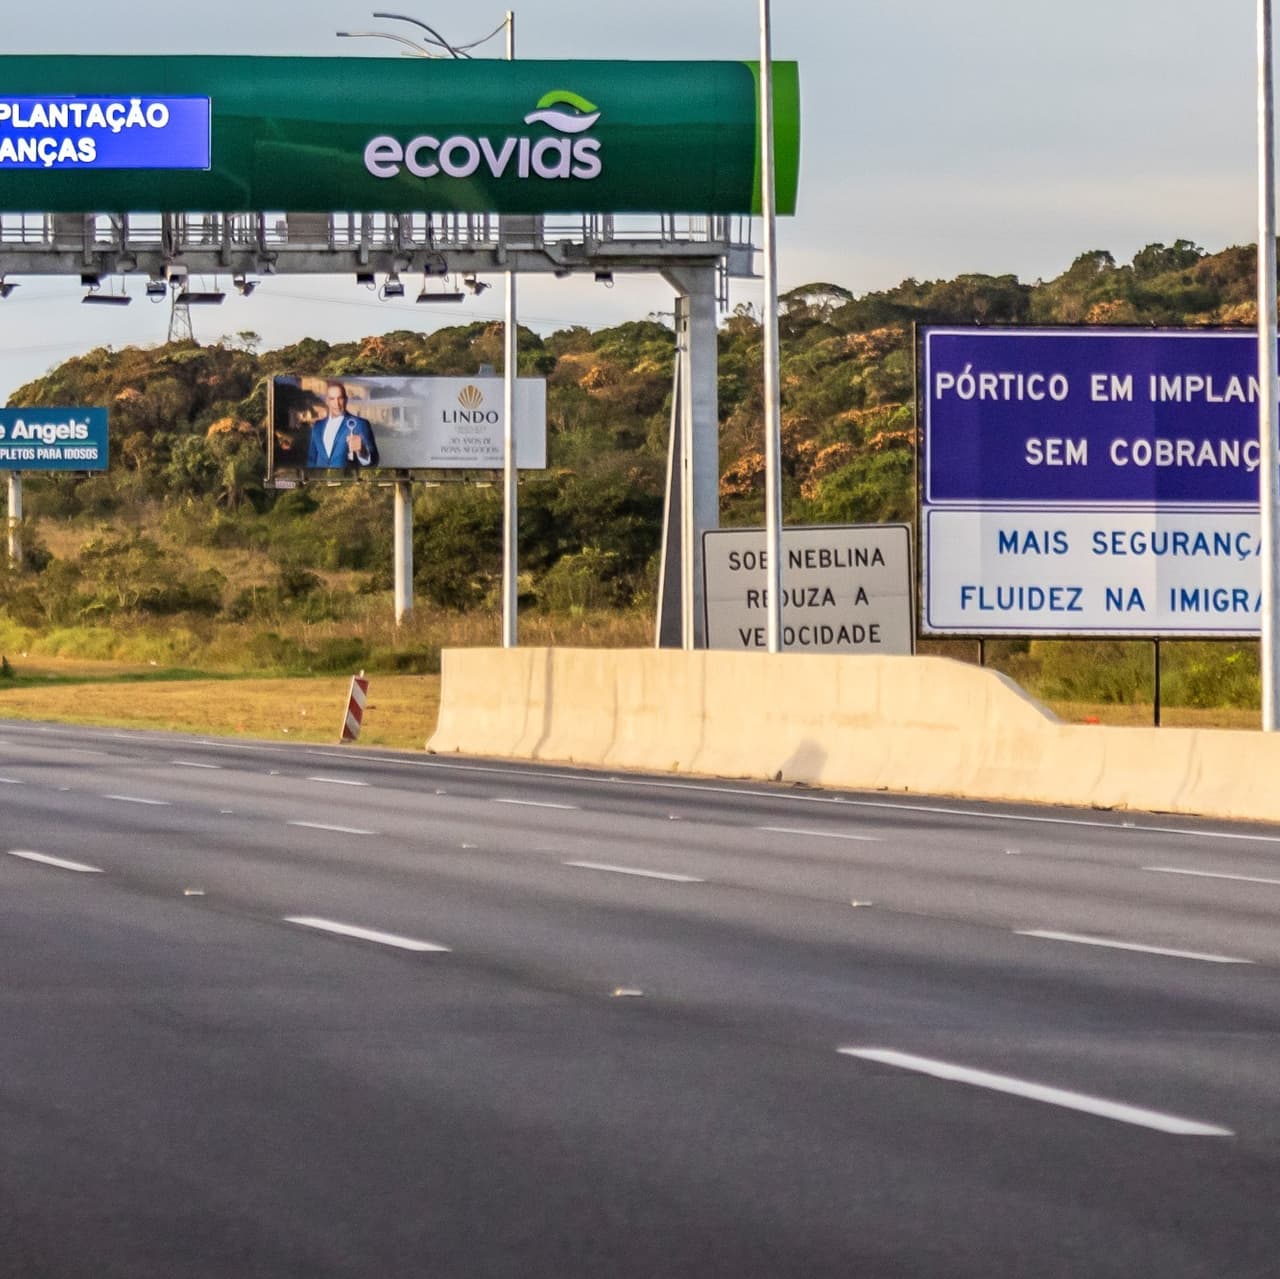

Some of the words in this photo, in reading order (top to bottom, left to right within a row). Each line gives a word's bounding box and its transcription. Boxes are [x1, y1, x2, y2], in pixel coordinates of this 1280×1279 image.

[364, 136, 601, 178] ecovias
[936, 364, 1068, 400] PÓRTICO
[1092, 374, 1132, 401] EM
[443, 411, 498, 423] LINDO
[12, 419, 89, 444] Angels
[37, 448, 61, 459] PARA
[64, 448, 97, 459] IDOSOS
[1026, 438, 1087, 465] SEM
[789, 548, 885, 568] NEBLINA
[999, 531, 1068, 554] MAIS
[1093, 531, 1261, 561] SEGURANÇ
[855, 587, 868, 605] A
[961, 586, 1082, 611] FLUIDEZ
[1106, 588, 1145, 610] NA
[739, 624, 881, 647] VEOCIDADE
